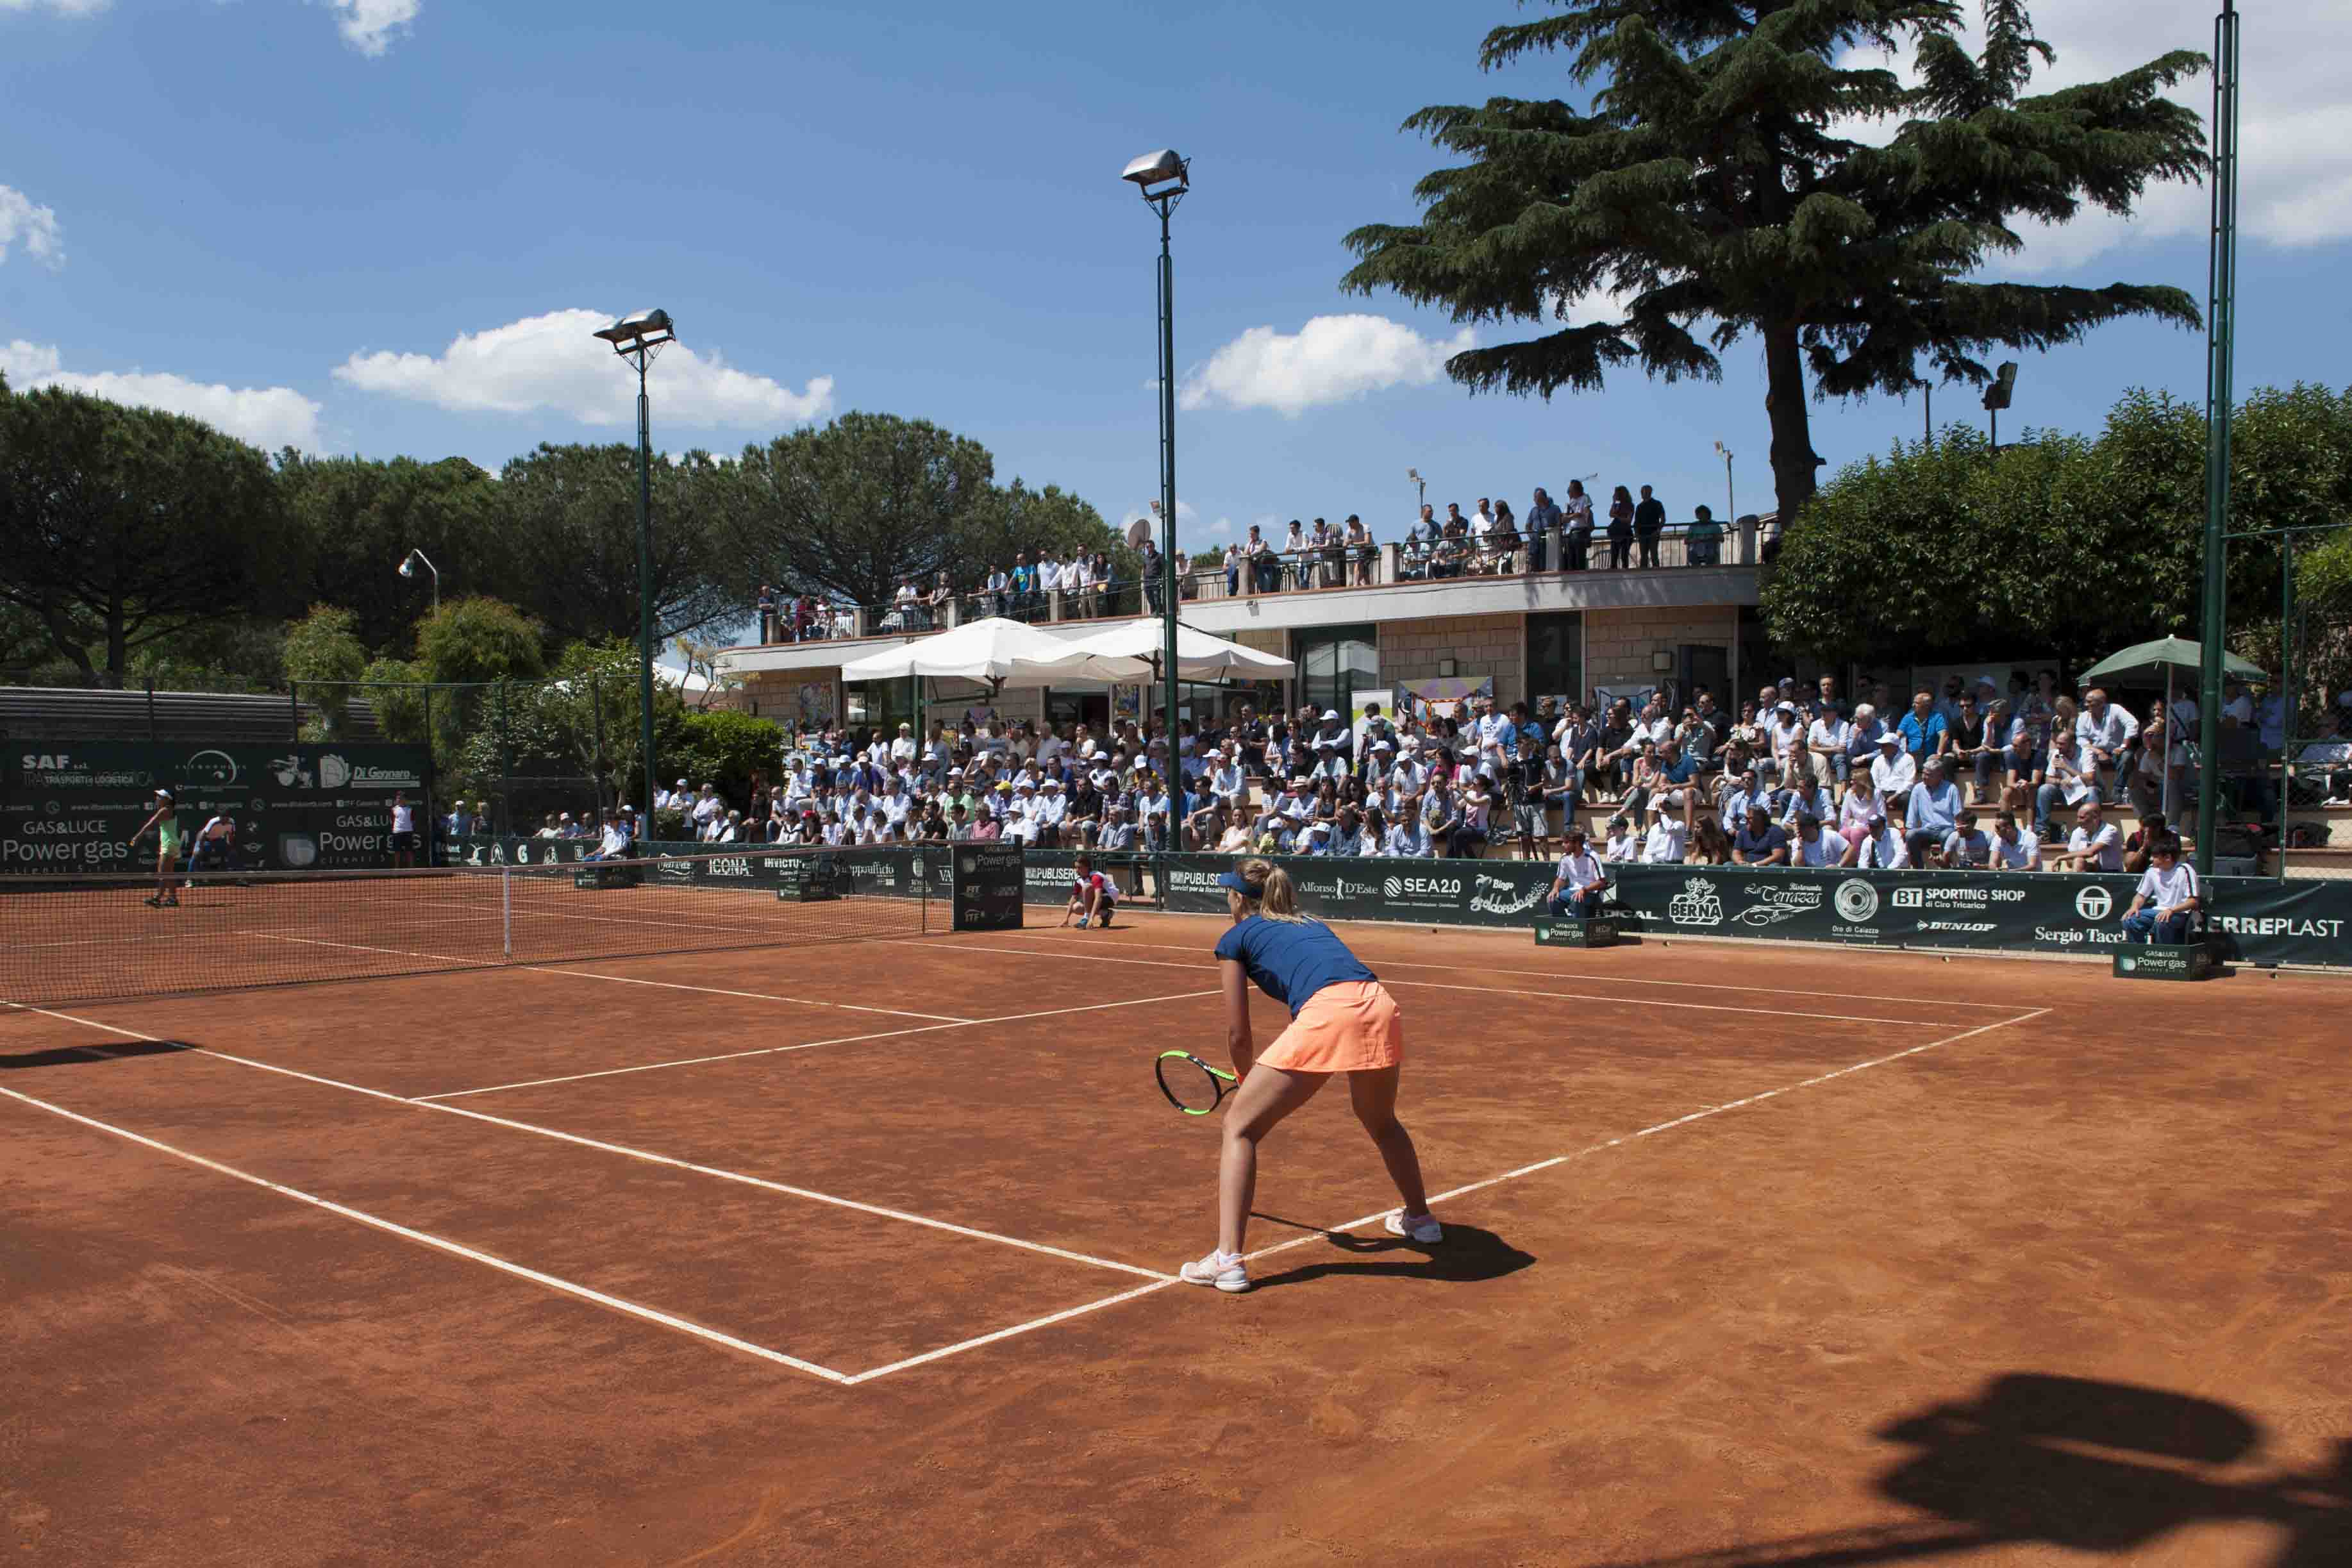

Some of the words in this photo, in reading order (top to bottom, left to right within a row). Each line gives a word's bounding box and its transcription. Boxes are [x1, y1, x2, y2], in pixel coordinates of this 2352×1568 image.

[22, 755, 69, 769] SAF
[23, 821, 108, 835] GAS&LUCE
[337, 816, 390, 828] GAS&LU
[319, 832, 421, 854] Powergs
[3, 840, 128, 863] Powergas
[708, 859, 749, 875] ICONA
[764, 858, 805, 869] INVICTU
[977, 855, 1021, 867] Powergas
[1037, 867, 1080, 880] PUBLISERV
[1298, 881, 1336, 893] Alfonso
[1345, 883, 1379, 894] D'Este
[1492, 878, 1515, 891] Bingo
[1762, 885, 1822, 903] Terrazza
[1925, 888, 1988, 901] SPORTING
[1991, 890, 2026, 902] SHOP
[1670, 903, 1723, 919] BERNA
[1953, 901, 1987, 910] Tricarico
[1550, 928, 1584, 938] Powergas
[1855, 926, 1880, 934] Caiazzo
[1928, 921, 1998, 932] DUNLOP
[2206, 917, 2344, 938] ERREPLAST
[2034, 926, 2083, 945] Sergio
[2137, 956, 2187, 969] Powergas
